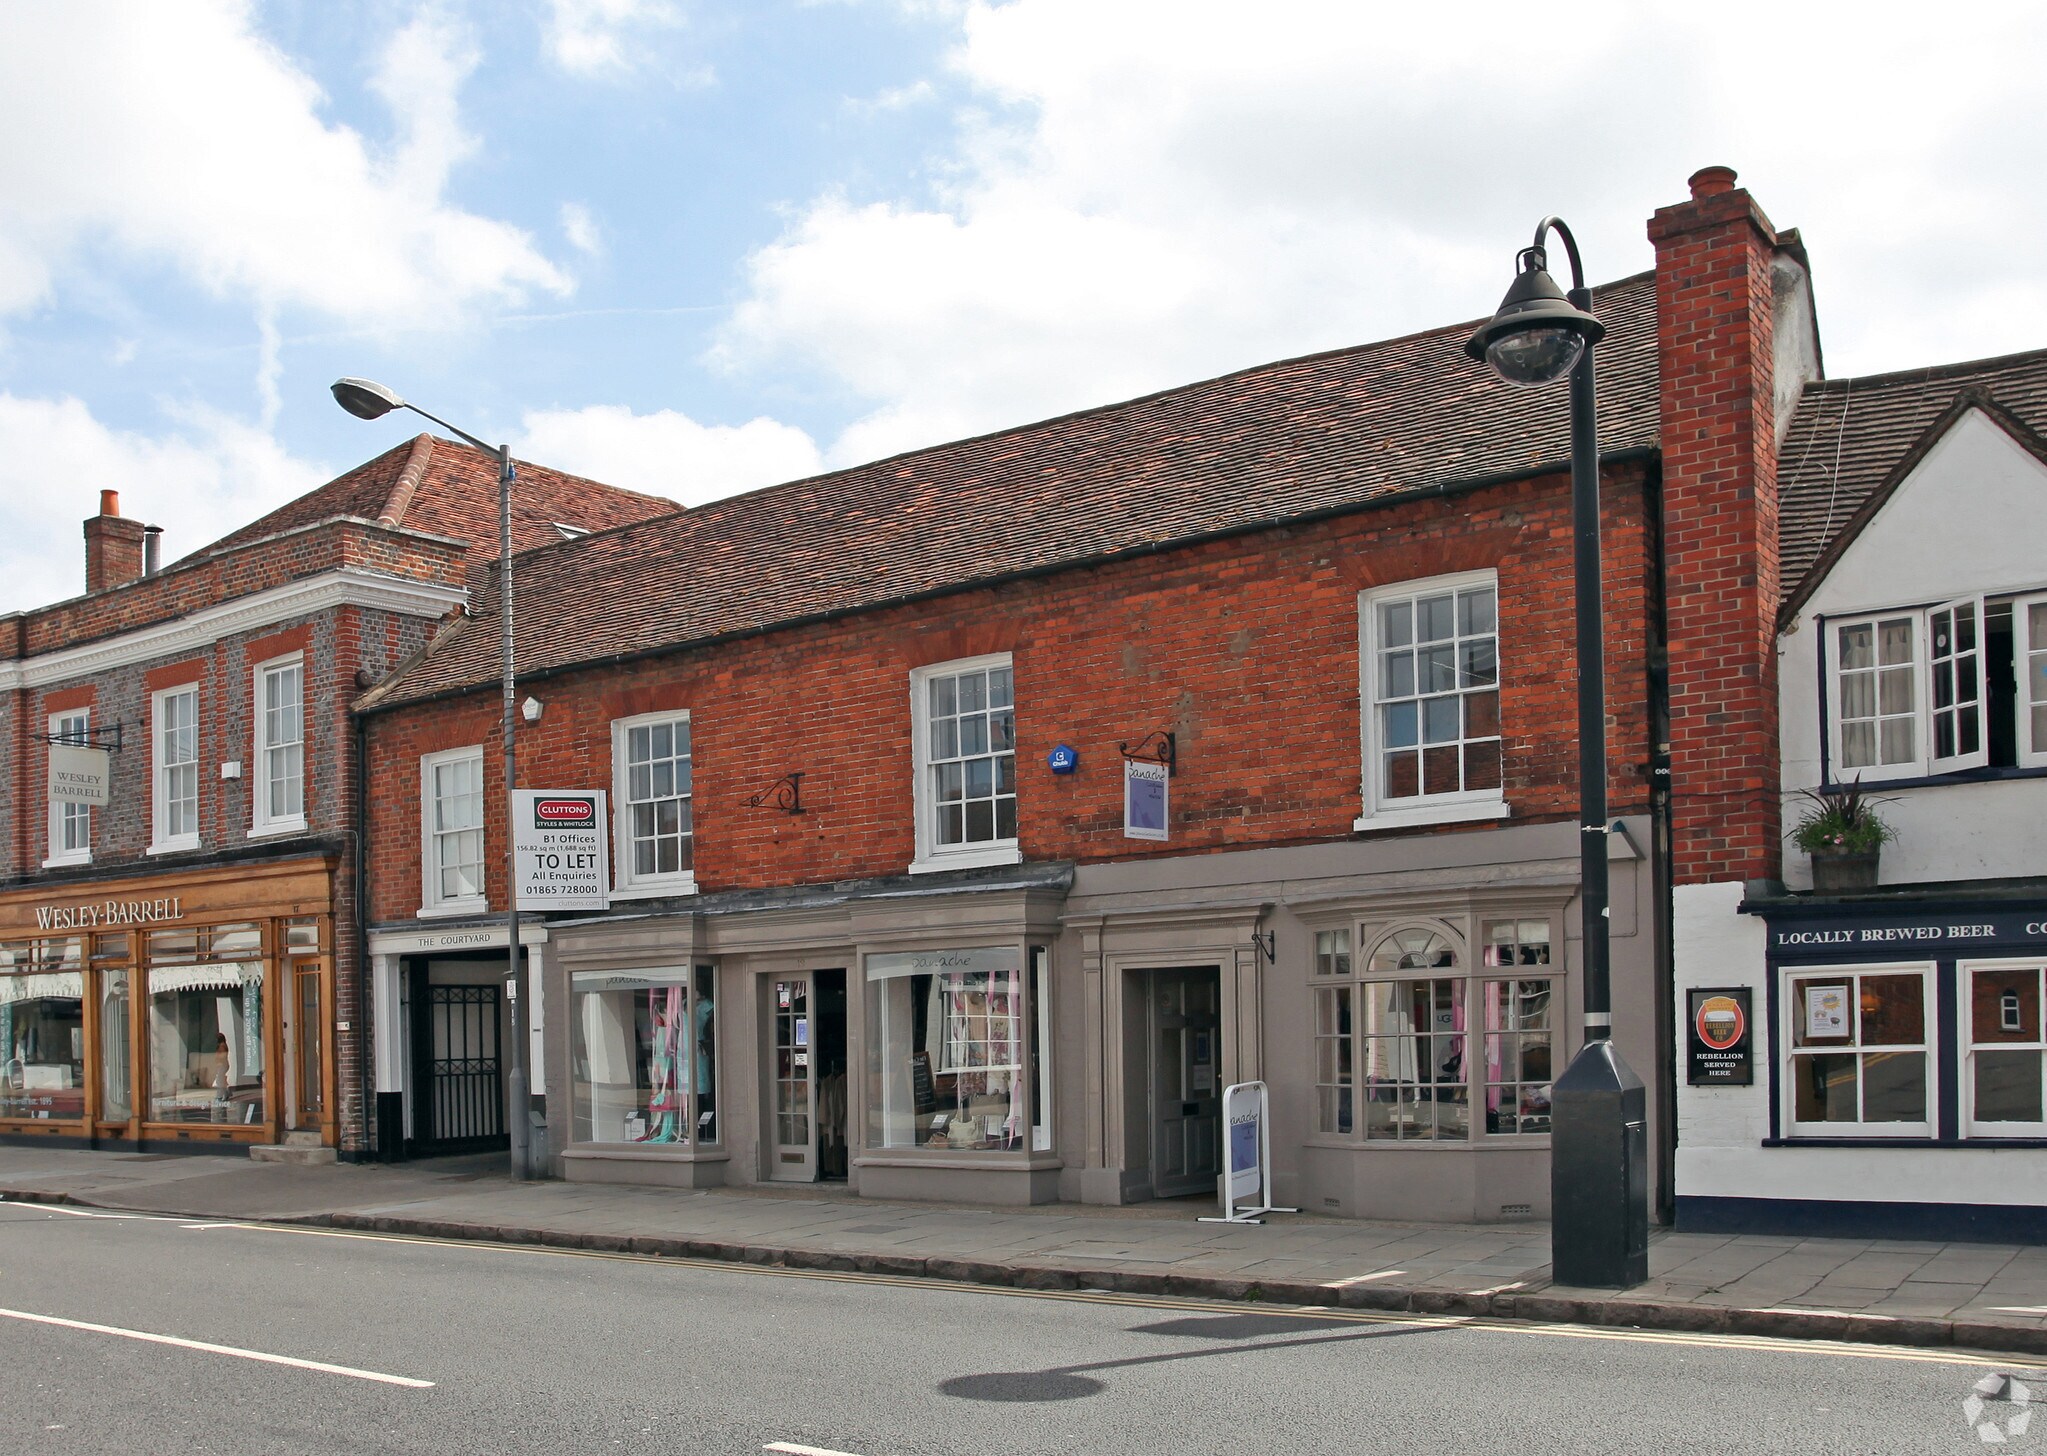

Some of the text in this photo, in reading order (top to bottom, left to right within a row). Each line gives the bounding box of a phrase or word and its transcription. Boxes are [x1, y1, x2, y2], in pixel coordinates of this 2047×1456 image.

[57, 771, 101, 784] WESLEY
[1128, 766, 1166, 781] panache
[53, 785, 103, 798] BARRELL
[541, 806, 588, 814] CLUTTONS
[543, 834, 595, 843] B1 Offices
[587, 844, 596, 852] ft)
[535, 854, 596, 869] TO LET
[532, 871, 597, 881] All Enquiries
[526, 885, 598, 894] 01865 728000
[35, 897, 184, 930] WESLEY-BARRELL
[418, 933, 491, 946] THE COURTYARD
[1778, 930, 1855, 945] LOCALLY
[1861, 926, 1942, 942] BREWED
[1947, 924, 1996, 938] BEER
[245, 997, 250, 1008] up
[245, 1009, 251, 1017] to
[1229, 1109, 1258, 1126] anache
